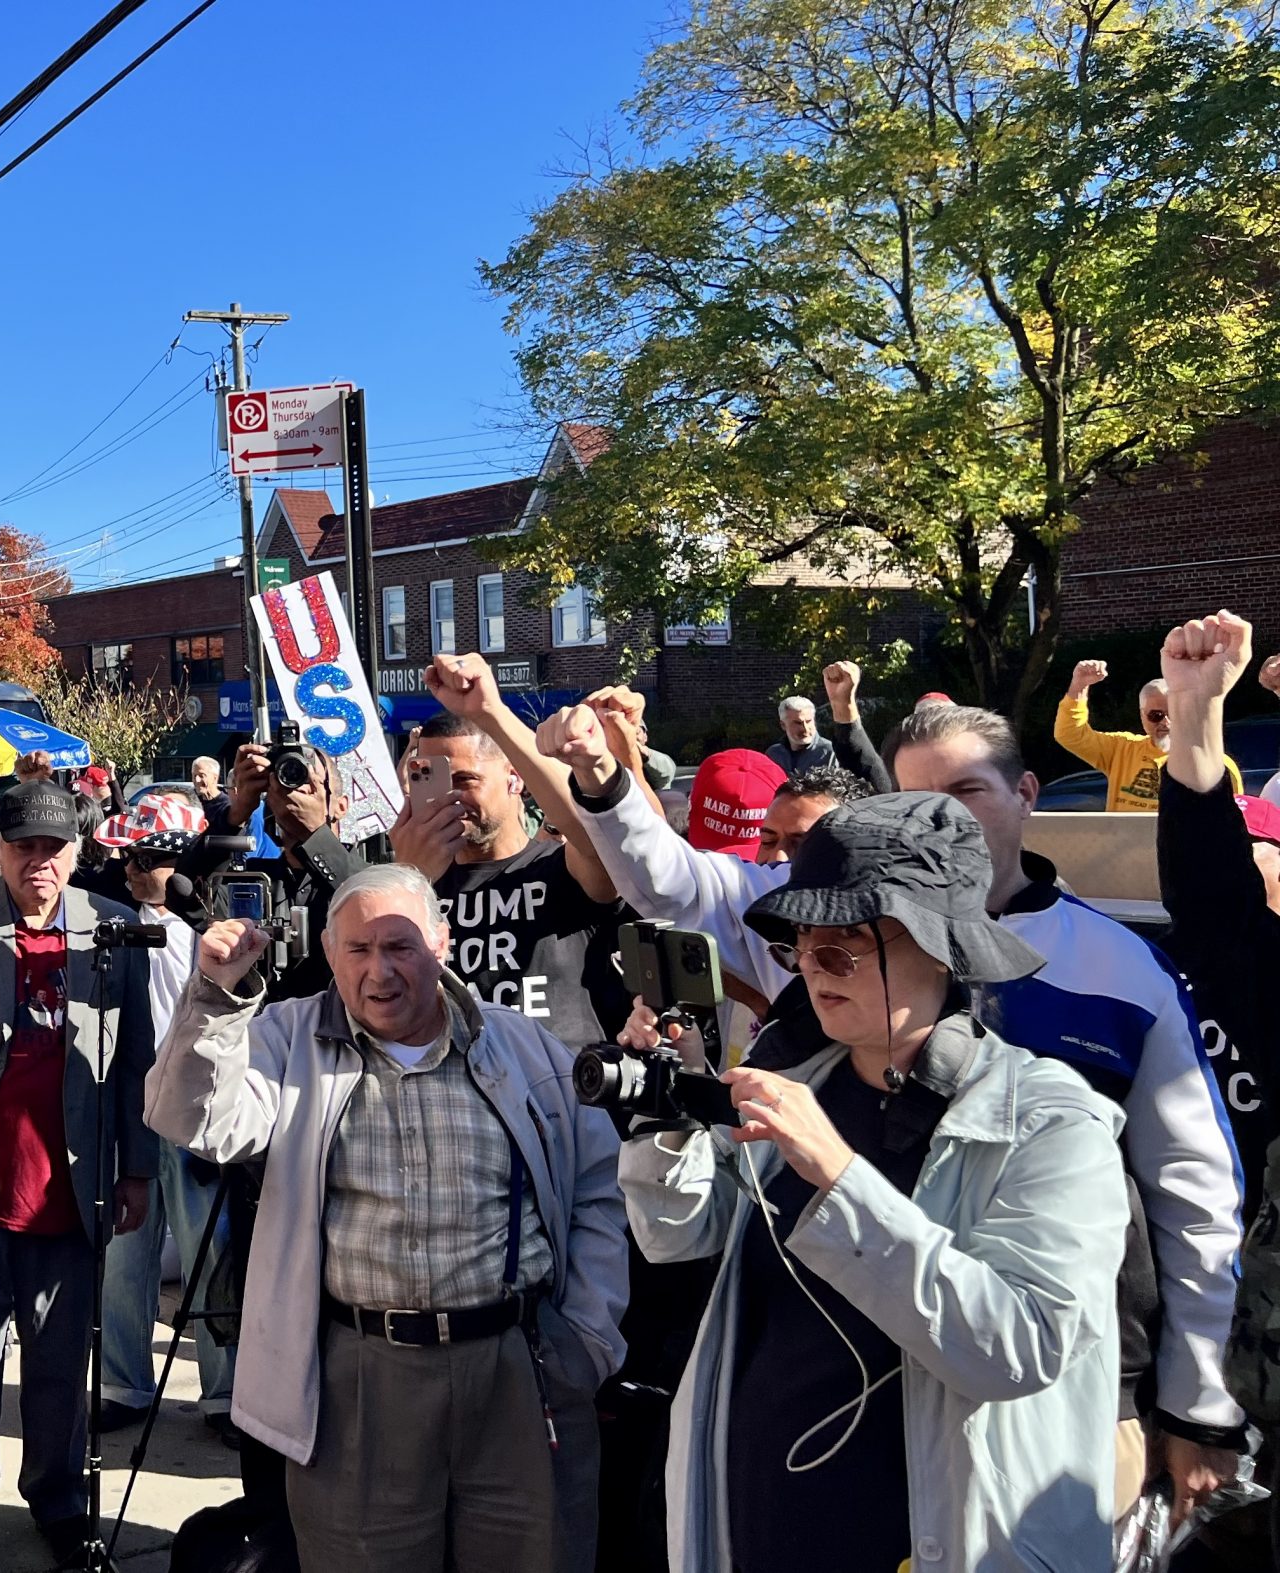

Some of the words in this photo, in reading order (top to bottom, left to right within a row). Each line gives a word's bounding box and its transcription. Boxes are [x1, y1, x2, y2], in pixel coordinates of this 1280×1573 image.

[271, 399, 308, 410] Monday
[273, 411, 315, 423] Thursday
[273, 428, 310, 440] 8:30am
[318, 425, 340, 436] 9am
[497, 667, 531, 682] 863-5077
[261, 575, 400, 844] USA
[31, 794, 67, 809] AMERICA
[703, 796, 731, 816] MAKE
[39, 810, 66, 823] AGAIN
[703, 816, 736, 836] GREAT
[738, 826, 761, 838] AGA
[437, 881, 547, 929] RUMP
